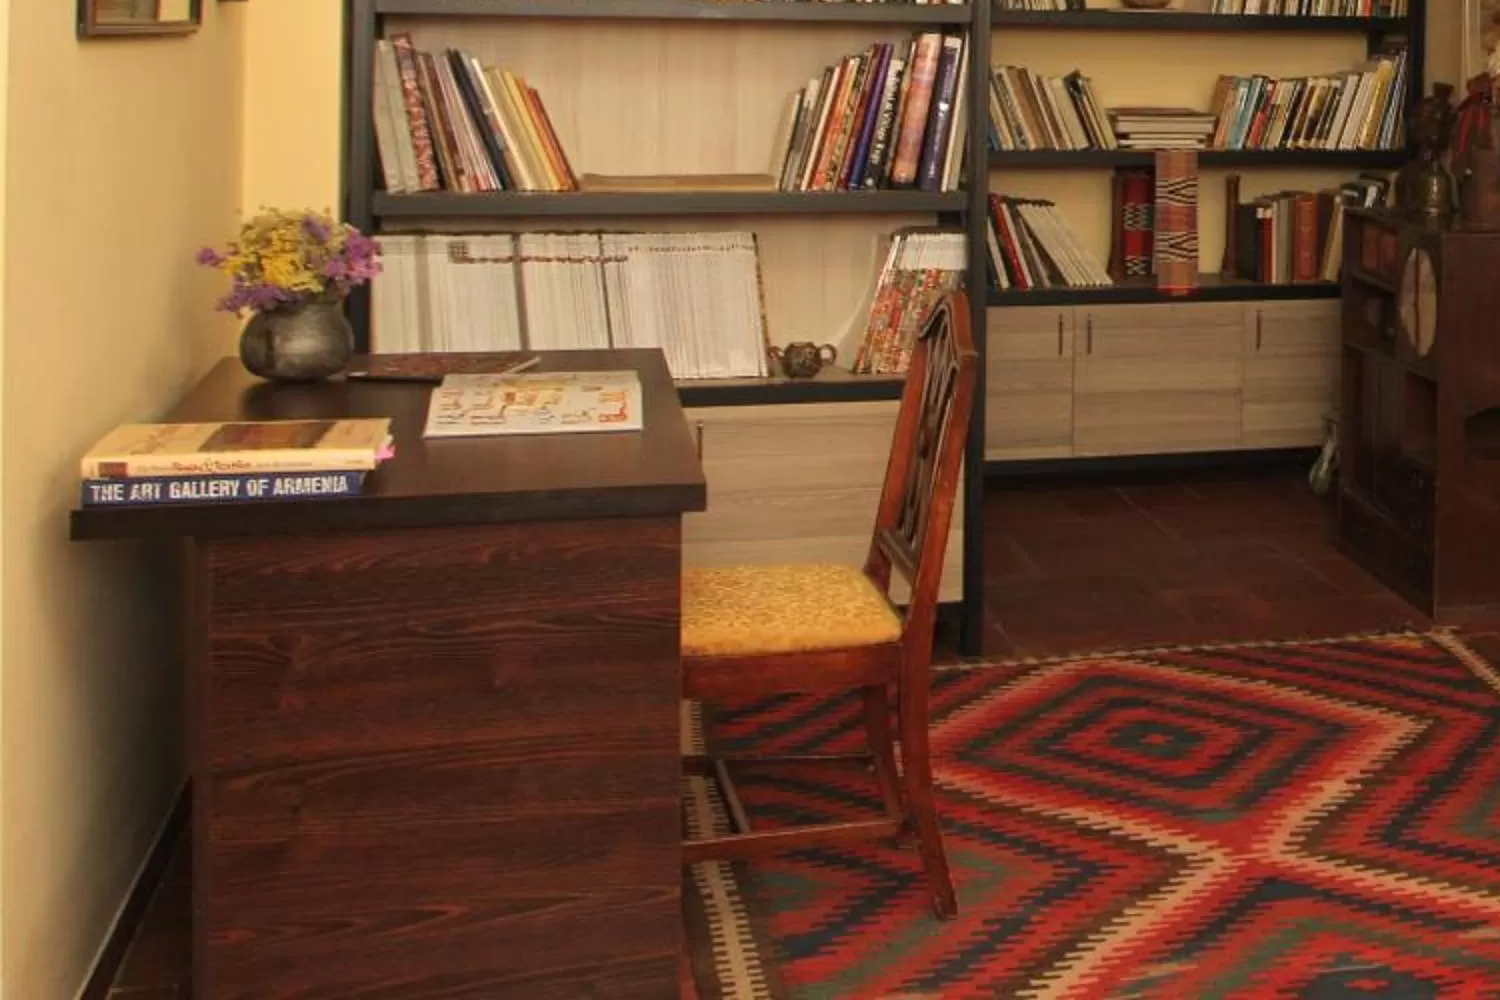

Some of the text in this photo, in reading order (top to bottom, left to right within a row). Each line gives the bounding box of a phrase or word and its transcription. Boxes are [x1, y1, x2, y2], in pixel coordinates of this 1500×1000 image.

[89, 475, 348, 501] THE ART GALLERY OF ARMENIA
